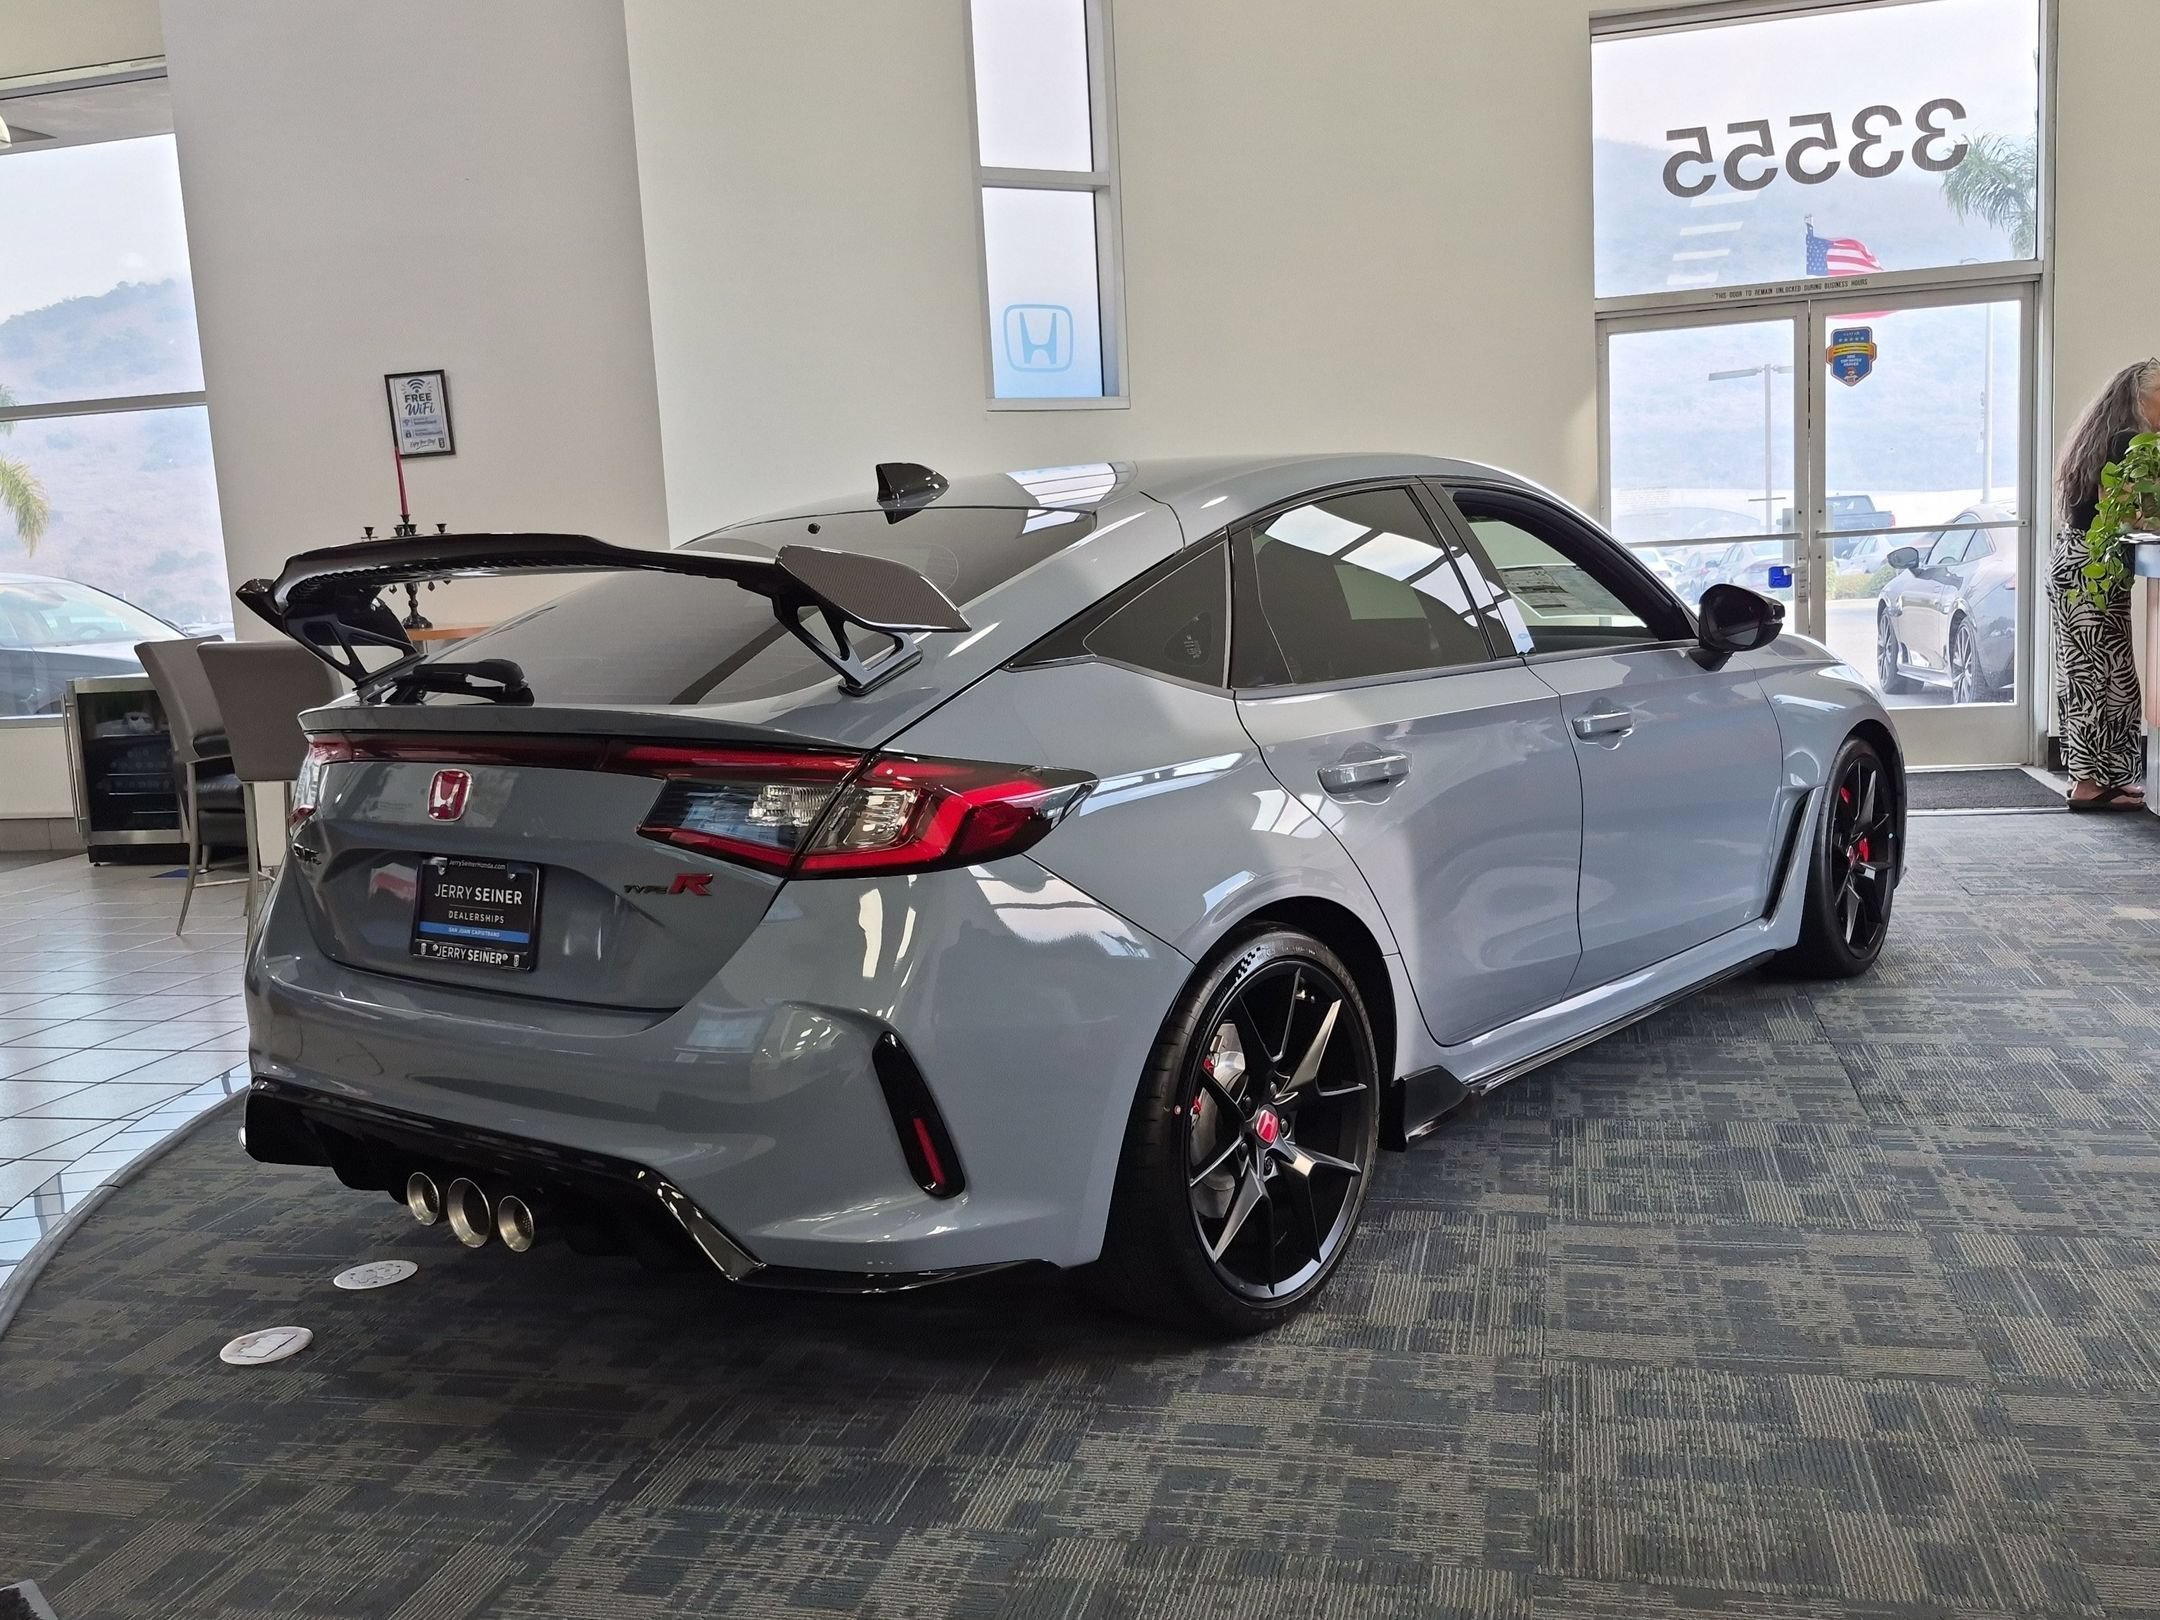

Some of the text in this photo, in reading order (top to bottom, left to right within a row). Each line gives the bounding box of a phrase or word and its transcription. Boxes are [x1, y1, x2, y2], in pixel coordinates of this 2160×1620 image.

[1745, 289, 1752, 297] TO
[1754, 288, 1773, 296] REMAIN
[1775, 285, 1801, 295] UNLOCKED
[1803, 283, 1822, 291] DURING
[1824, 281, 1849, 289] BUSINESS
[404, 392, 432, 403] FREE
[405, 402, 435, 416] WiFi
[667, 872, 714, 896] R
[434, 883, 523, 905] JERRY SEINER
[448, 910, 505, 924] DEALERSHIPS
[436, 944, 502, 965] JERRY SEINER
